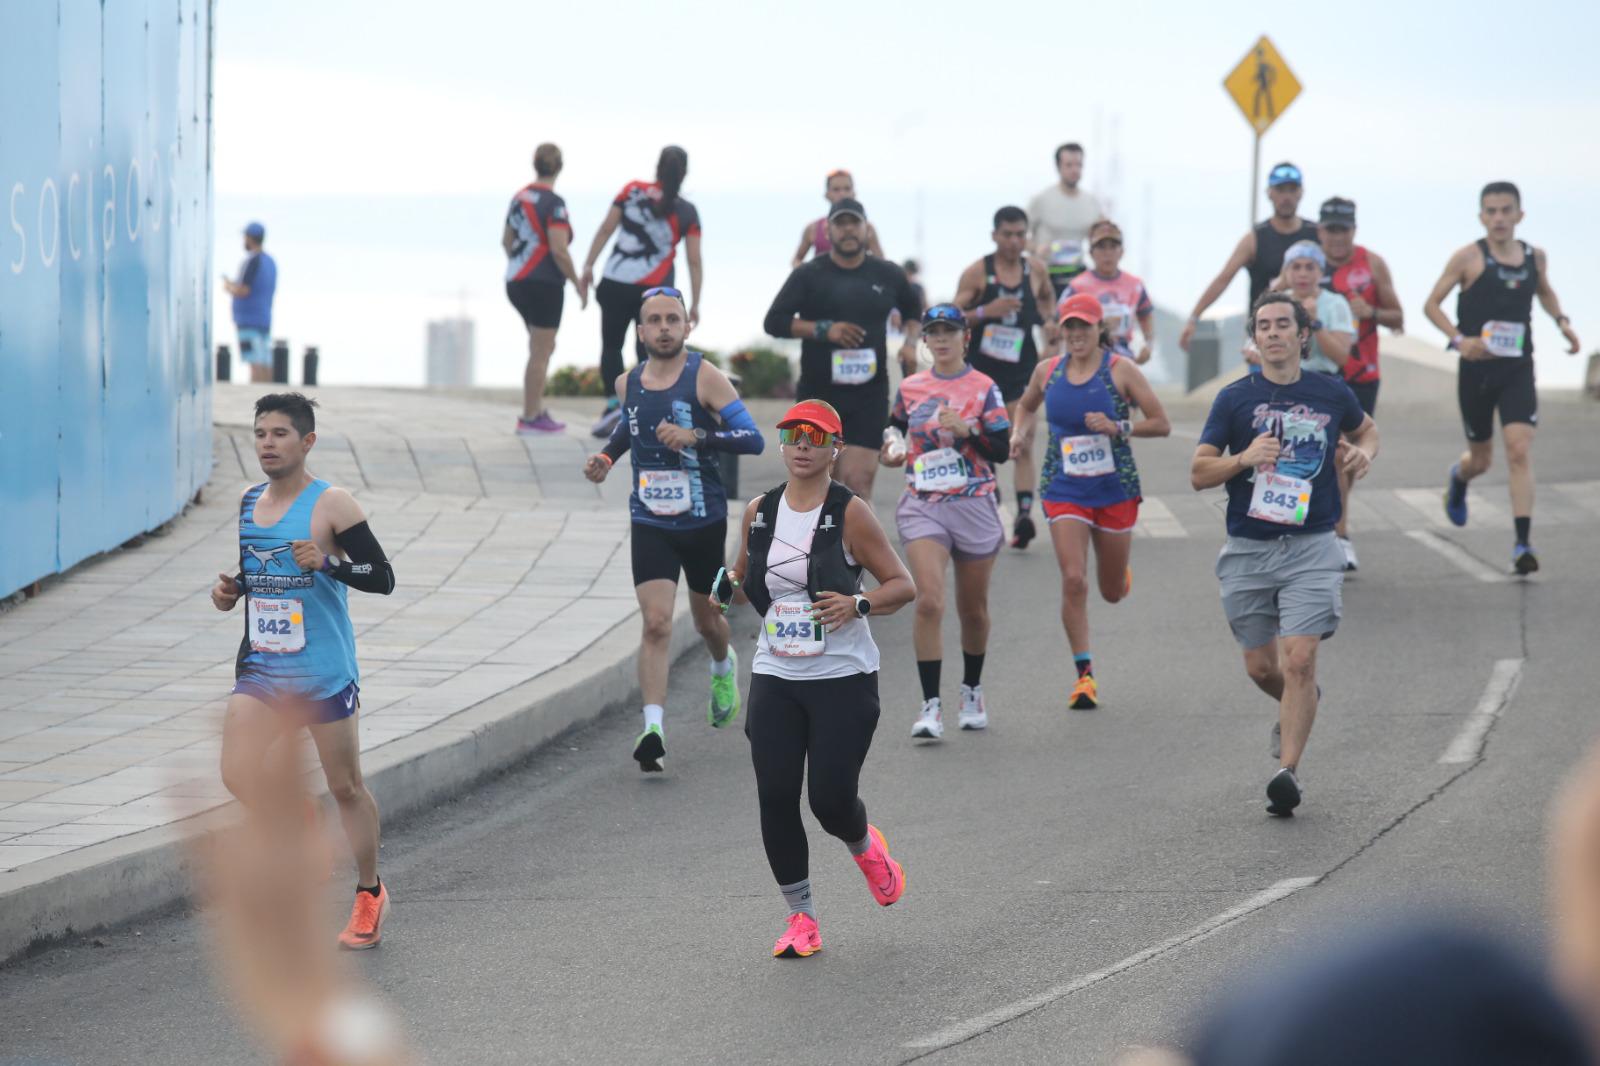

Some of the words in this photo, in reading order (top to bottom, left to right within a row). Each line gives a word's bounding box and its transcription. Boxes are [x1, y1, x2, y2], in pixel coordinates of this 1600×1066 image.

[1068, 449, 1105, 465] 6019
[921, 462, 959, 480] 1505
[643, 487, 684, 500] 5223
[1263, 490, 1298, 509] 843
[257, 617, 291, 635] 842
[776, 621, 811, 638] 243
